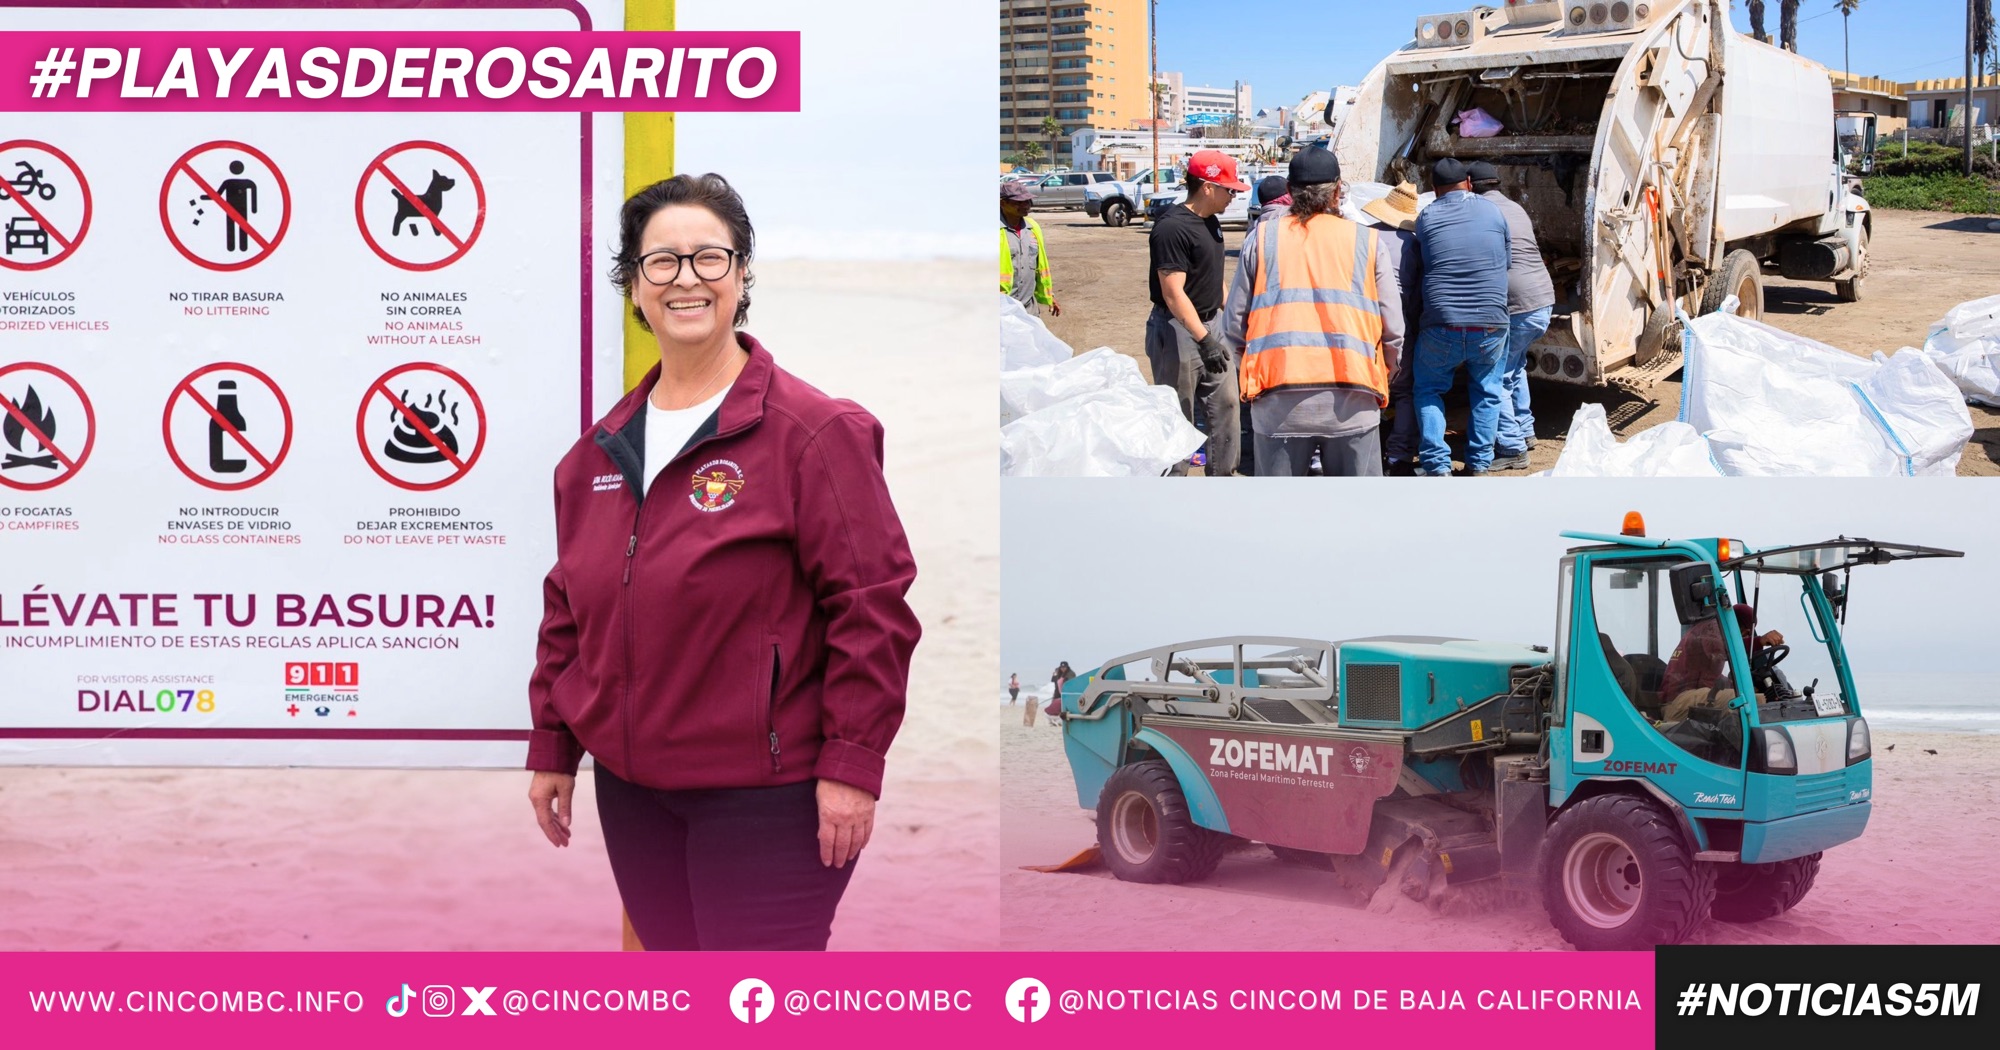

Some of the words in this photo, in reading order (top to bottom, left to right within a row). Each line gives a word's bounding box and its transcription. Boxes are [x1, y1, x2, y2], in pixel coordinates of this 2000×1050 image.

[3, 289, 76, 301] VEHÍCULOS
[169, 292, 188, 302] NO
[191, 292, 229, 302] TIRAR
[232, 292, 285, 302] BASURA
[380, 292, 399, 302] NO
[402, 292, 468, 302] ANIMALES
[0, 305, 76, 315] TORIZADOS
[184, 306, 204, 316] NO
[206, 306, 270, 316] LITTERING
[386, 306, 407, 316] SIN
[409, 306, 462, 316] CORREA
[48, 320, 110, 331] VEHICLES
[384, 321, 404, 331] NO
[406, 321, 463, 331] ANIMALS
[366, 335, 427, 345] WITHOUT
[428, 335, 438, 345] A
[441, 335, 481, 345] LEASH
[14, 507, 73, 517] FOGATAS
[179, 507, 199, 517] NO
[201, 507, 280, 517] INTRODUCIR
[388, 507, 461, 517] PROHIBIDO
[8, 520, 80, 531] CAMPFIRES
[167, 520, 224, 531] ENVASES
[227, 520, 245, 531] DE
[247, 520, 292, 531] VIDRIO
[356, 521, 398, 531] DEJAR
[400, 521, 494, 531] EXCREMENTOS
[158, 534, 178, 544] NO
[180, 534, 220, 545] GLASS
[222, 534, 302, 545] CONTAINERS
[343, 534, 363, 545] DO
[366, 534, 393, 545] NOT
[395, 534, 434, 545] LEAVE
[437, 534, 461, 545] PET
[463, 534, 507, 545] WASTE
[193, 593, 257, 628] TU
[276, 593, 495, 629] BASURA!
[5, 635, 157, 649] INCUMPLIMIENTO
[161, 635, 185, 649] DE
[189, 635, 241, 649] ESTAS
[246, 635, 312, 649] REGLAS
[315, 635, 378, 649] APLICA
[381, 633, 460, 650] SANCIÓN
[76, 674, 99, 684] FOR
[100, 674, 150, 684] VISITORS
[150, 674, 215, 684] ASSISTANCE
[288, 664, 353, 685] 911
[284, 693, 360, 702] EMERGENCIAS
[1209, 737, 1334, 776] ZOFEMAT
[1603, 760, 1678, 775] ZOFEMAT
[1209, 768, 1229, 779] Zona
[1229, 770, 1259, 782] Federal
[1260, 773, 1296, 785] Marítimo
[1297, 776, 1335, 790] Terrestre
[1693, 791, 1719, 804] Beach
[1719, 793, 1736, 805] Tech
